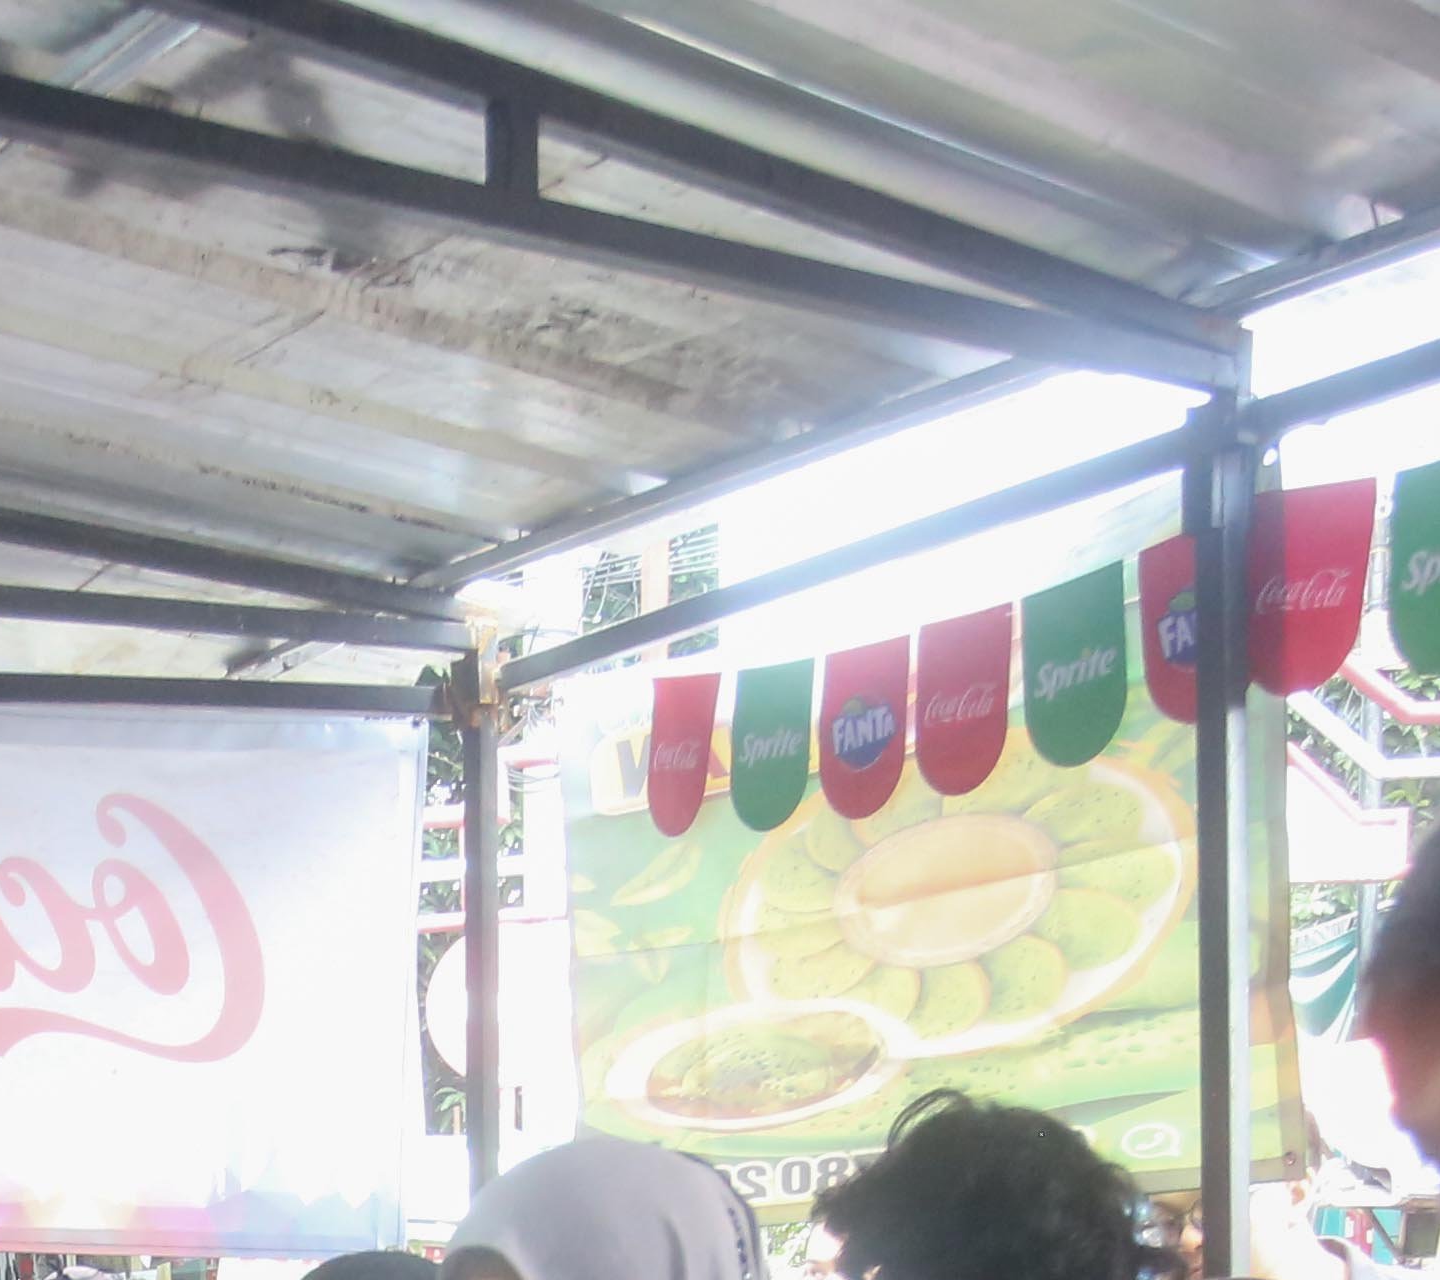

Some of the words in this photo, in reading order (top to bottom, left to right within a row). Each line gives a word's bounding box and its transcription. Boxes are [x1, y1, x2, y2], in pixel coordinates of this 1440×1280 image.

[1034, 644, 1118, 702] Sprite
[739, 726, 804, 766] Sprite
[832, 704, 897, 748] FANTA
